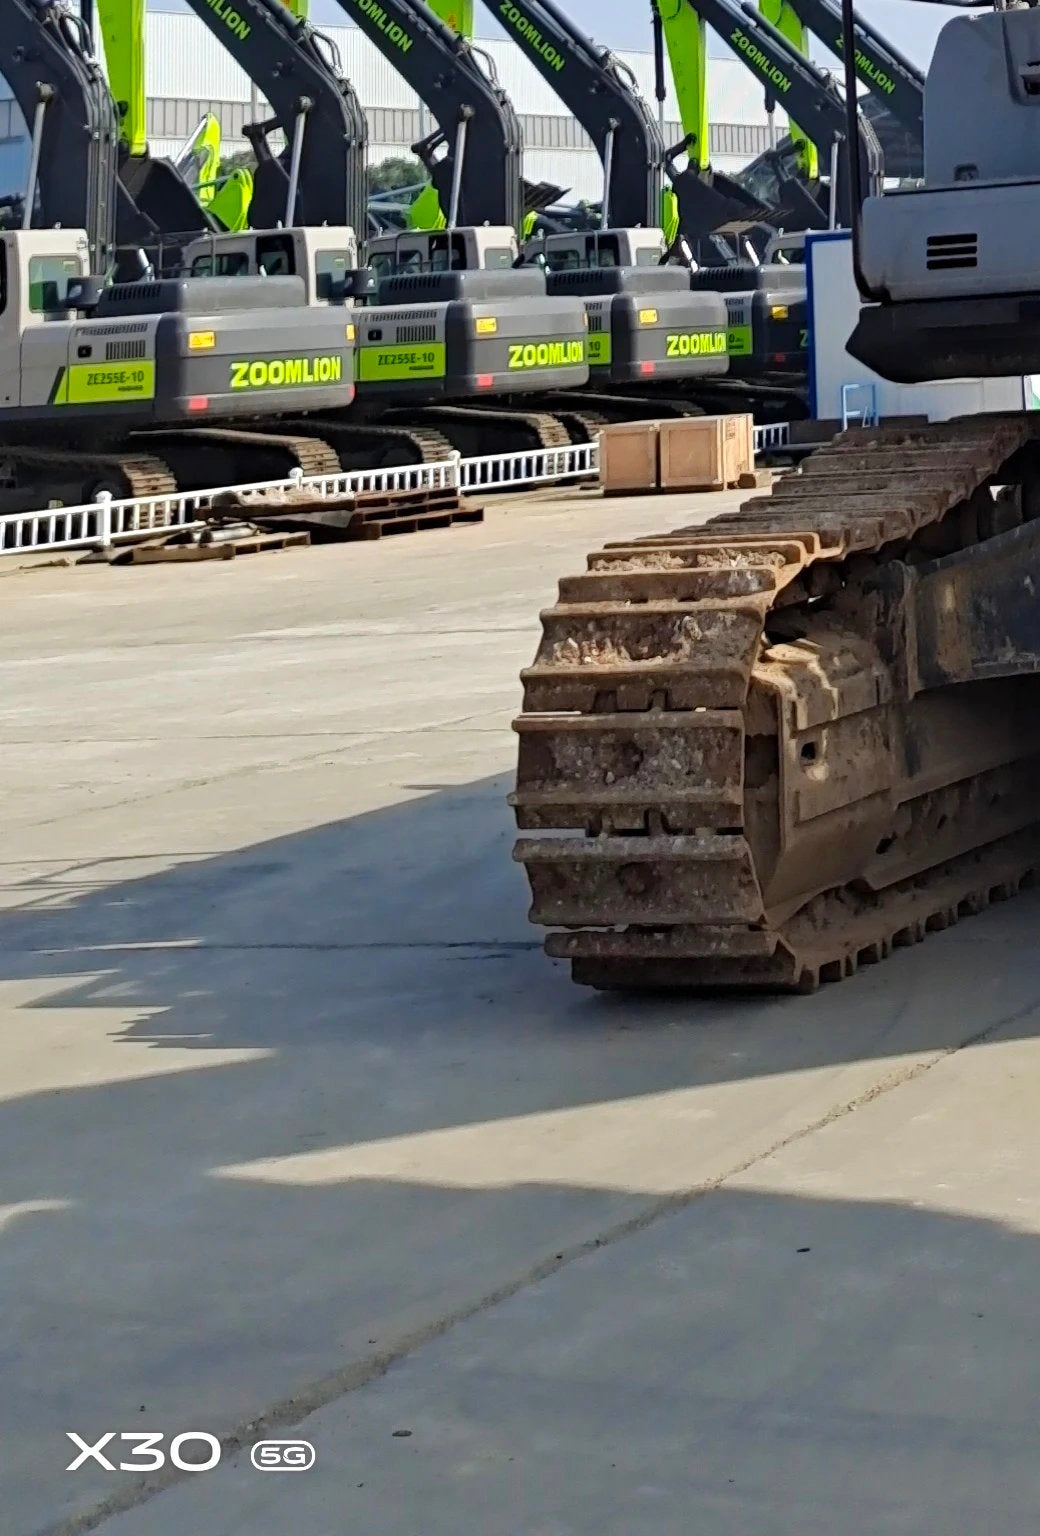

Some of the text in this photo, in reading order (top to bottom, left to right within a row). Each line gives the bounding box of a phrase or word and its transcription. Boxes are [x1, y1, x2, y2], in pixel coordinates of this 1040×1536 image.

[730, 27, 792, 93] ZOOMLION
[835, 32, 896, 94] ZOMLION
[508, 340, 584, 368] ZOOMLION
[86, 370, 144, 386] ZE255E-10
[229, 355, 341, 388] ZOOMLION
